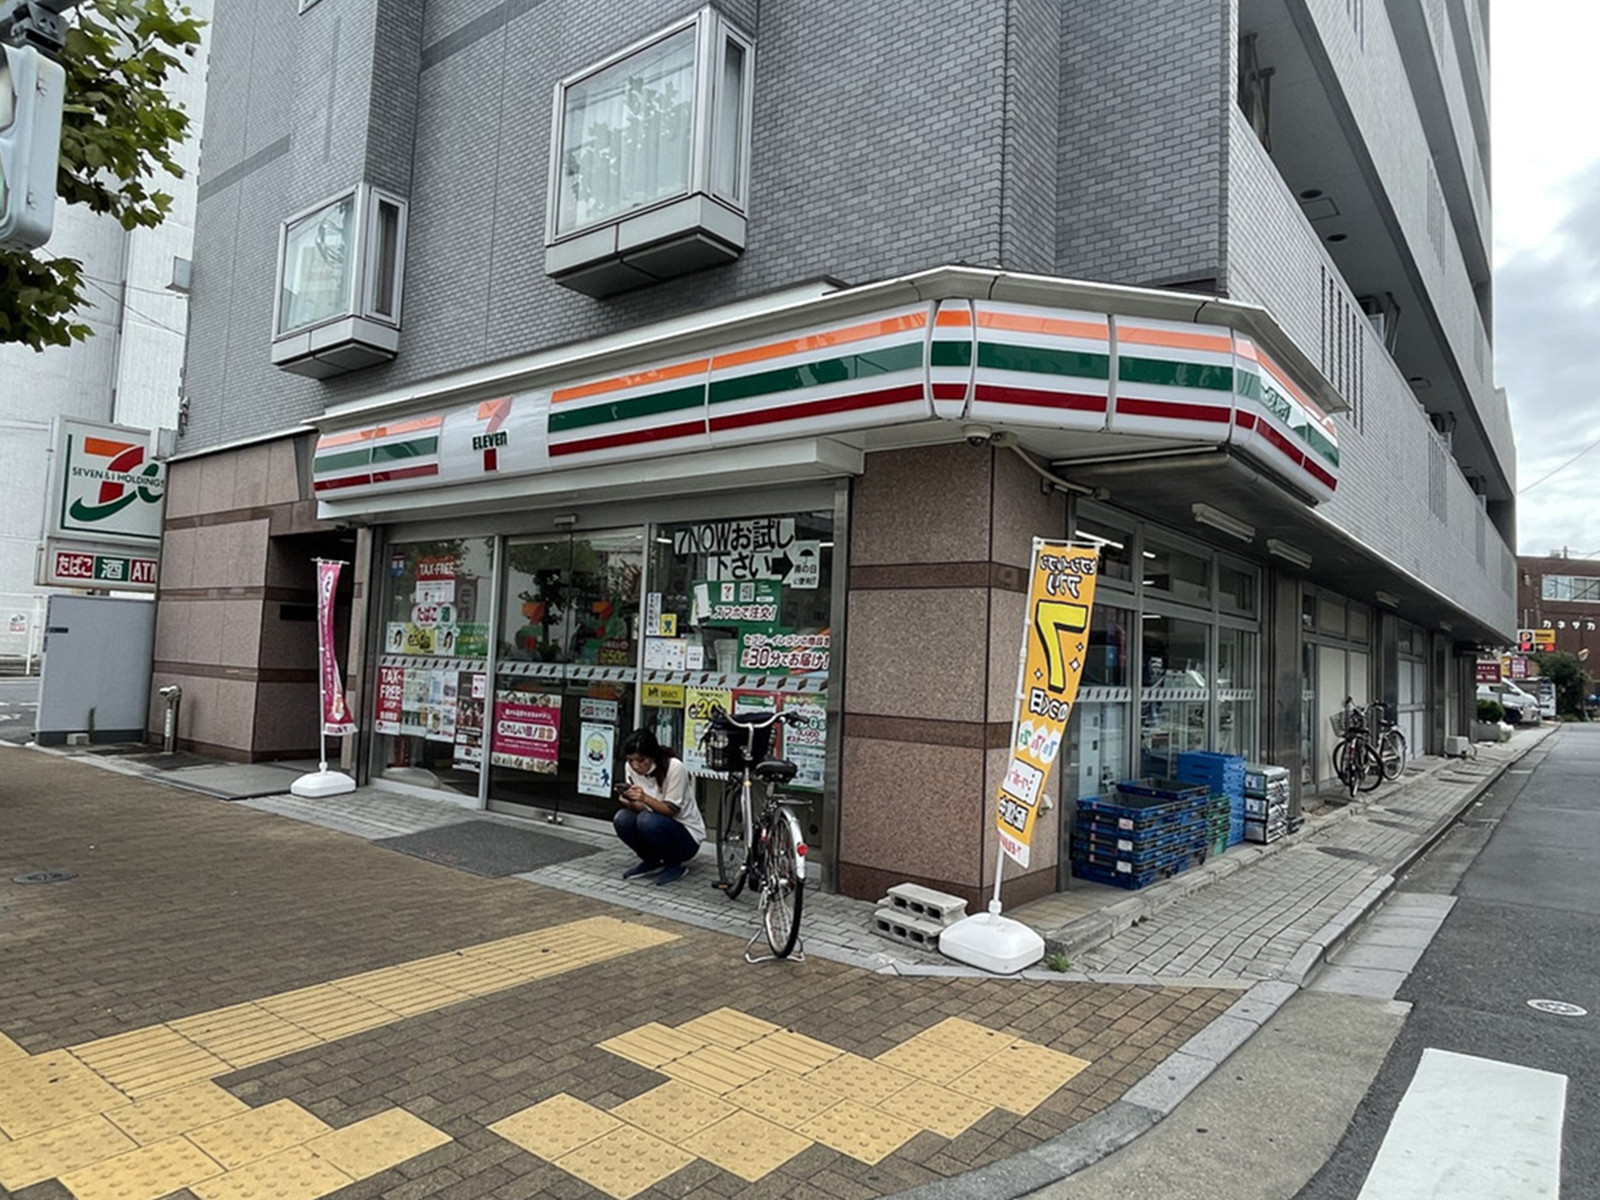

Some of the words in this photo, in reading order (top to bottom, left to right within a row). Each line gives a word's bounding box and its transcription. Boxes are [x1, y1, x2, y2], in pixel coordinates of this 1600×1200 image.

[72, 466, 104, 479] SEVEN
[56, 555, 93, 577] たばこ
[101, 558, 124, 579] 酒
[419, 562, 455, 576] TAX-FREE
[707, 551, 771, 580] 下さい
